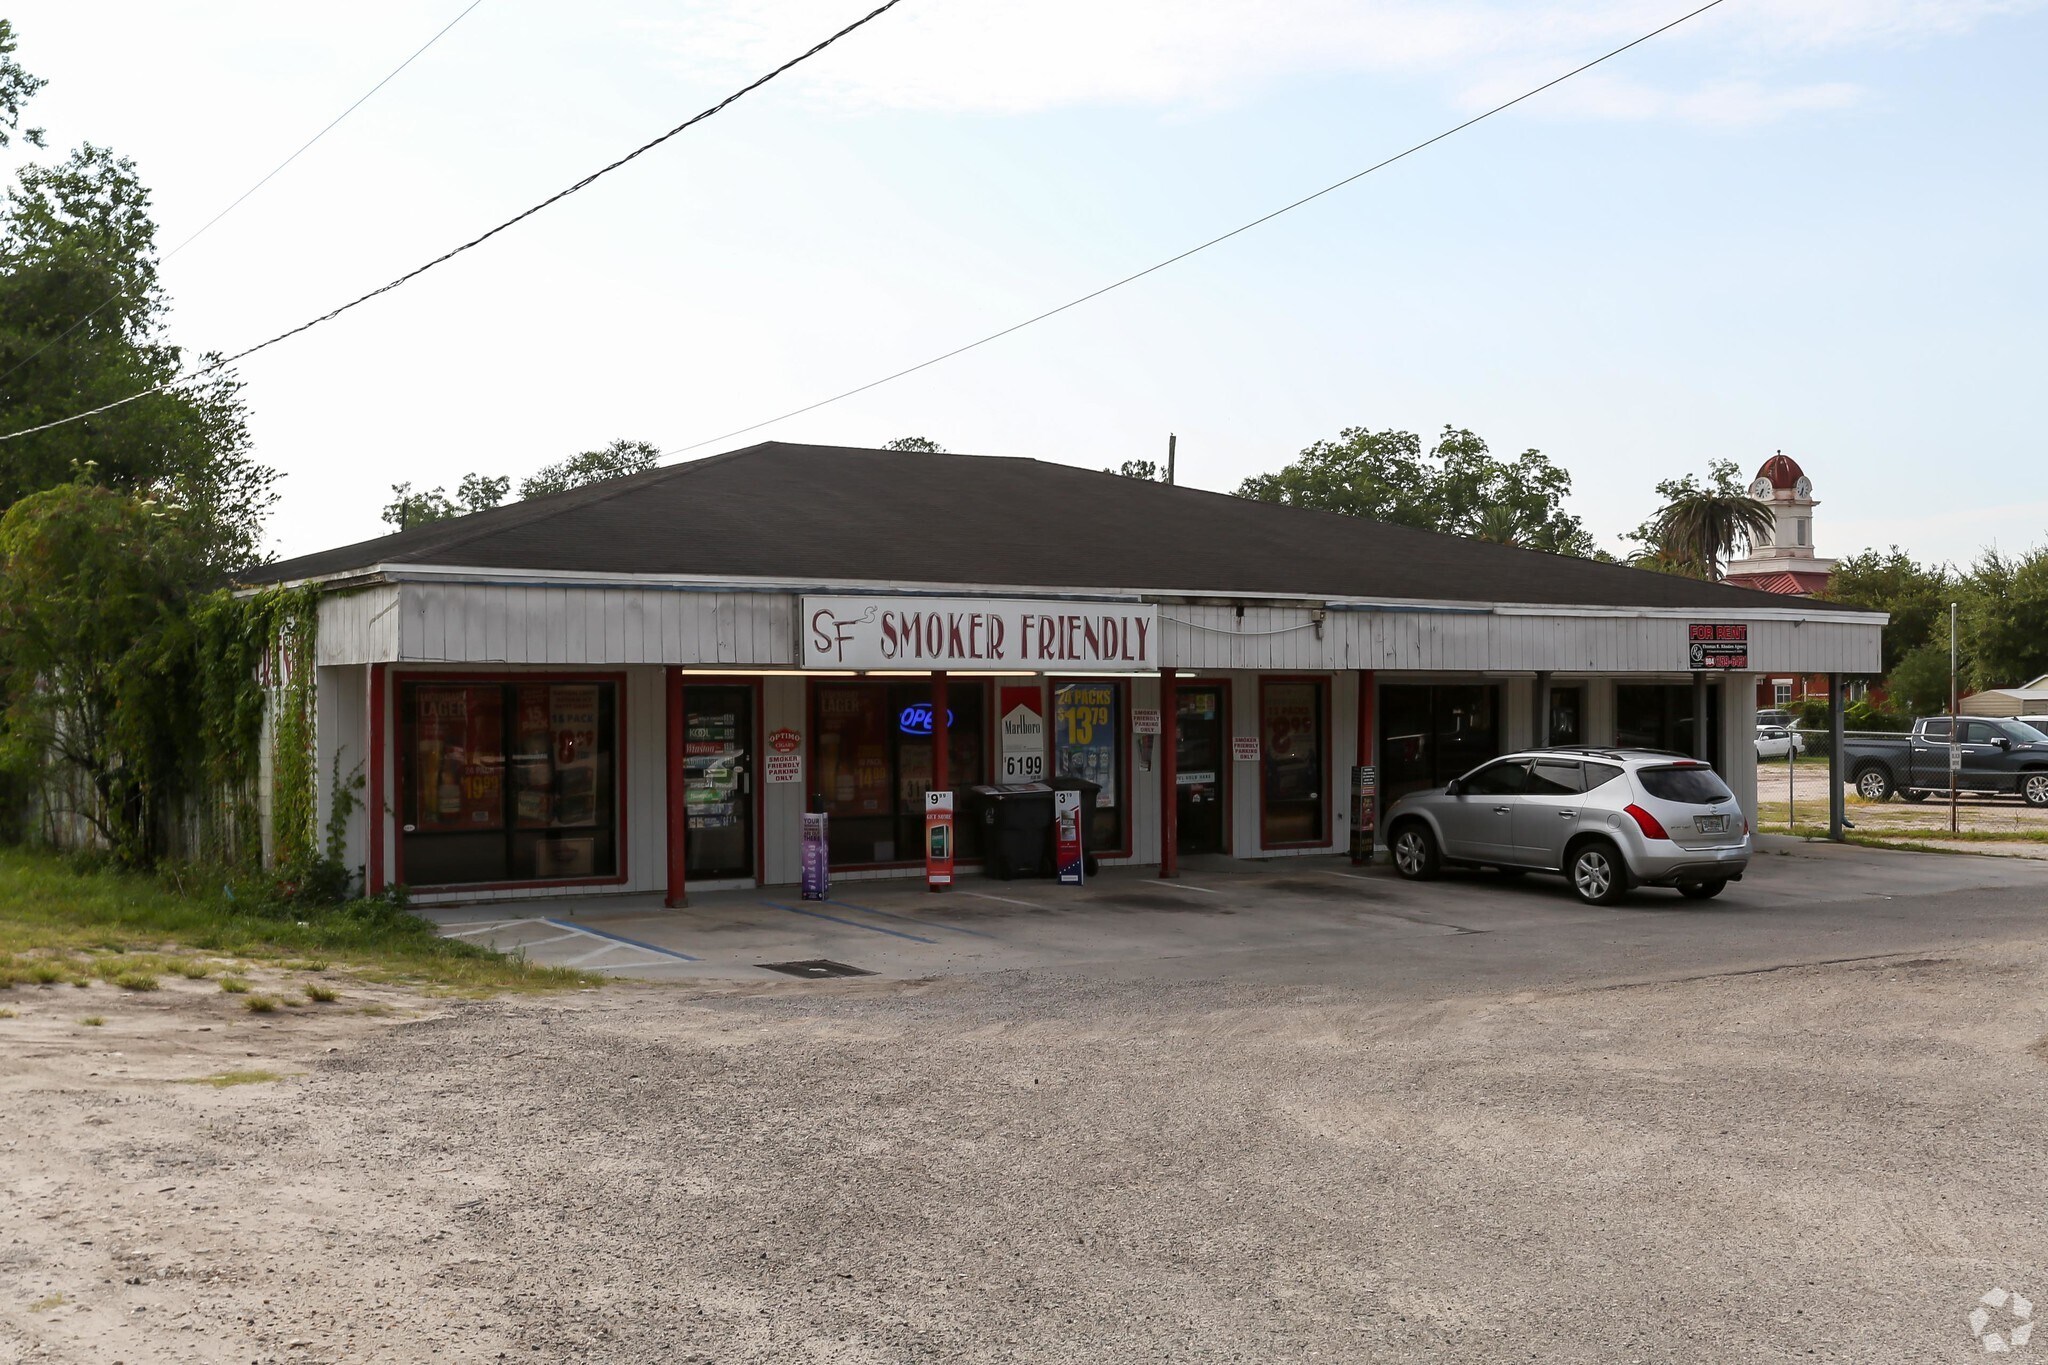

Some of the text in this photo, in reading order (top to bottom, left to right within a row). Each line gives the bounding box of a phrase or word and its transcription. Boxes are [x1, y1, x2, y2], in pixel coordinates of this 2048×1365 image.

[881, 610, 1005, 660] SMOKER
[1020, 613, 1151, 661] FRIENDLY
[1690, 625, 1747, 640] FOR RENT
[1075, 690, 1111, 705] PACKS
[421, 701, 467, 717] LAGER
[821, 700, 860, 713] LAGER
[567, 714, 594, 723] PACK
[900, 707, 933, 730] OPE
[1005, 715, 1041, 734] Marlboro
[689, 728, 710, 738] KOOL
[769, 732, 801, 742] OPTIMO
[686, 742, 715, 753] Winston
